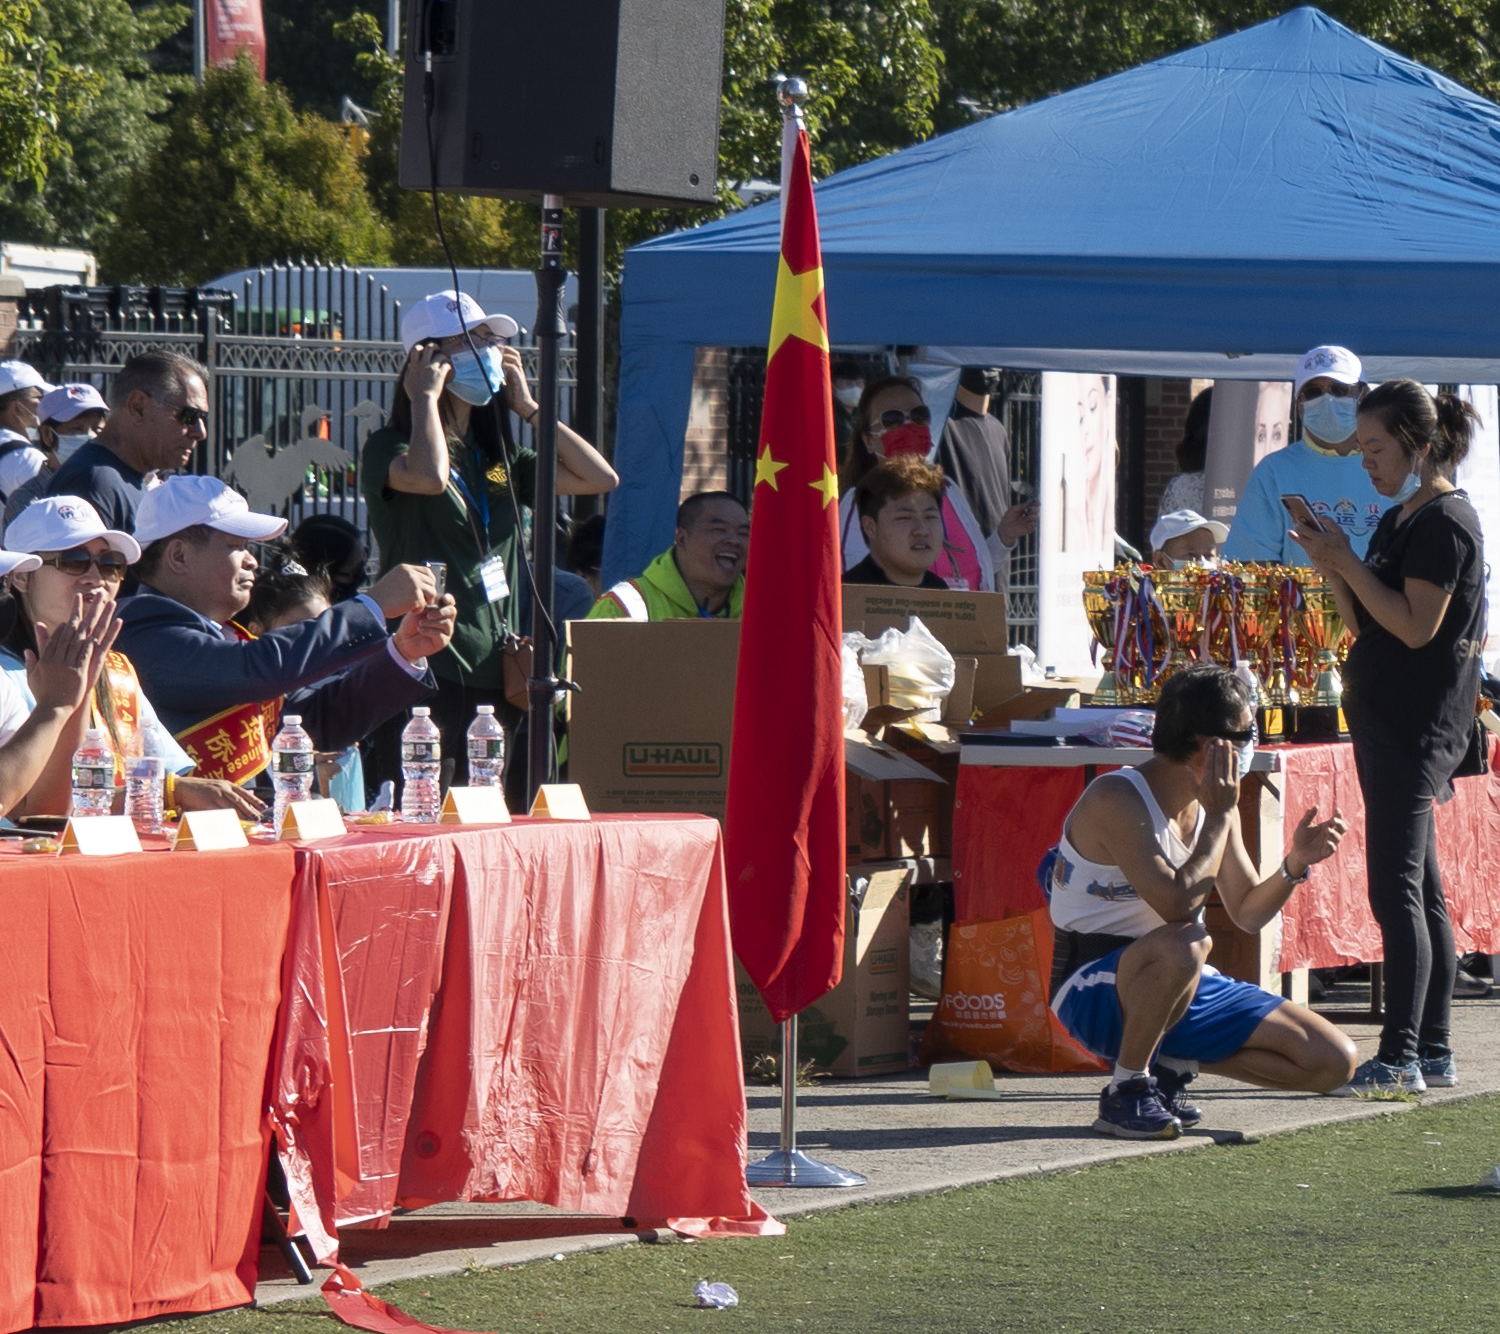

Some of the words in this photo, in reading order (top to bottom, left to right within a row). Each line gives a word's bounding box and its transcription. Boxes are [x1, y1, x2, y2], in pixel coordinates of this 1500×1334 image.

[227, 742, 268, 772] hinese
[630, 748, 716, 764] U-HAUL
[941, 992, 1005, 1011] FOODS
